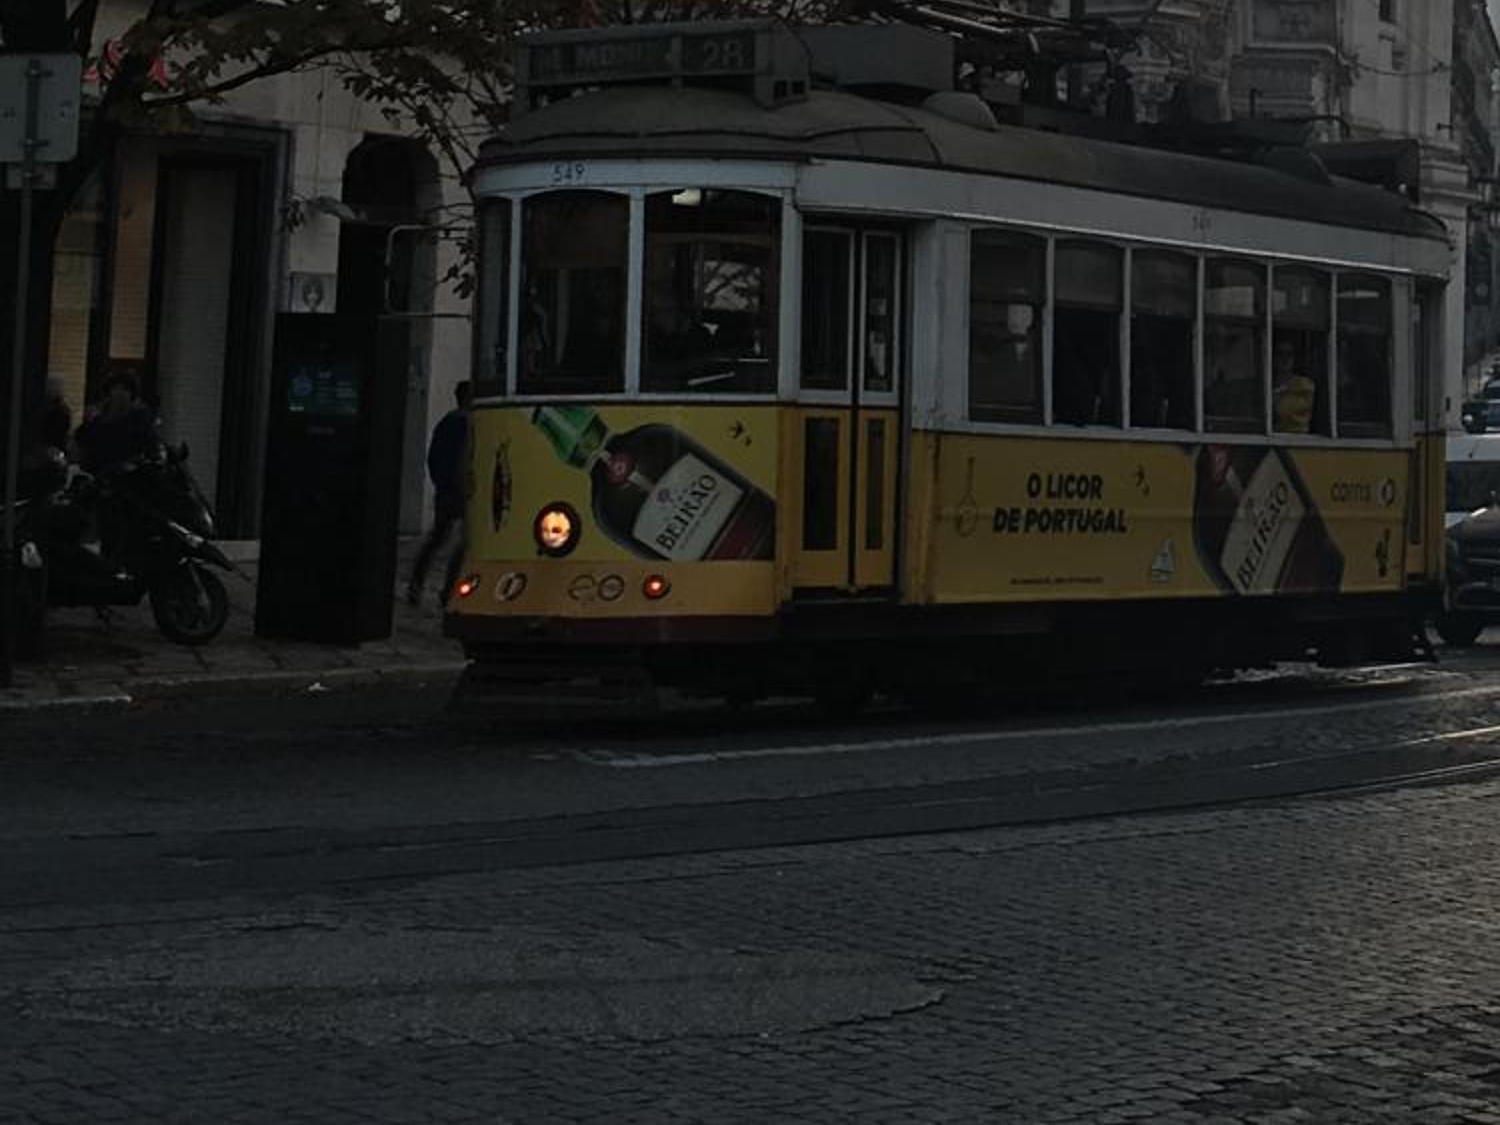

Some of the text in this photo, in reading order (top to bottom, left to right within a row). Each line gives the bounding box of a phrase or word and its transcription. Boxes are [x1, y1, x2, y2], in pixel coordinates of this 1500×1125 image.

[703, 38, 745, 69] 28
[1027, 473, 1102, 499] O LICOR
[992, 507, 1127, 533] DE PORTUGAL
